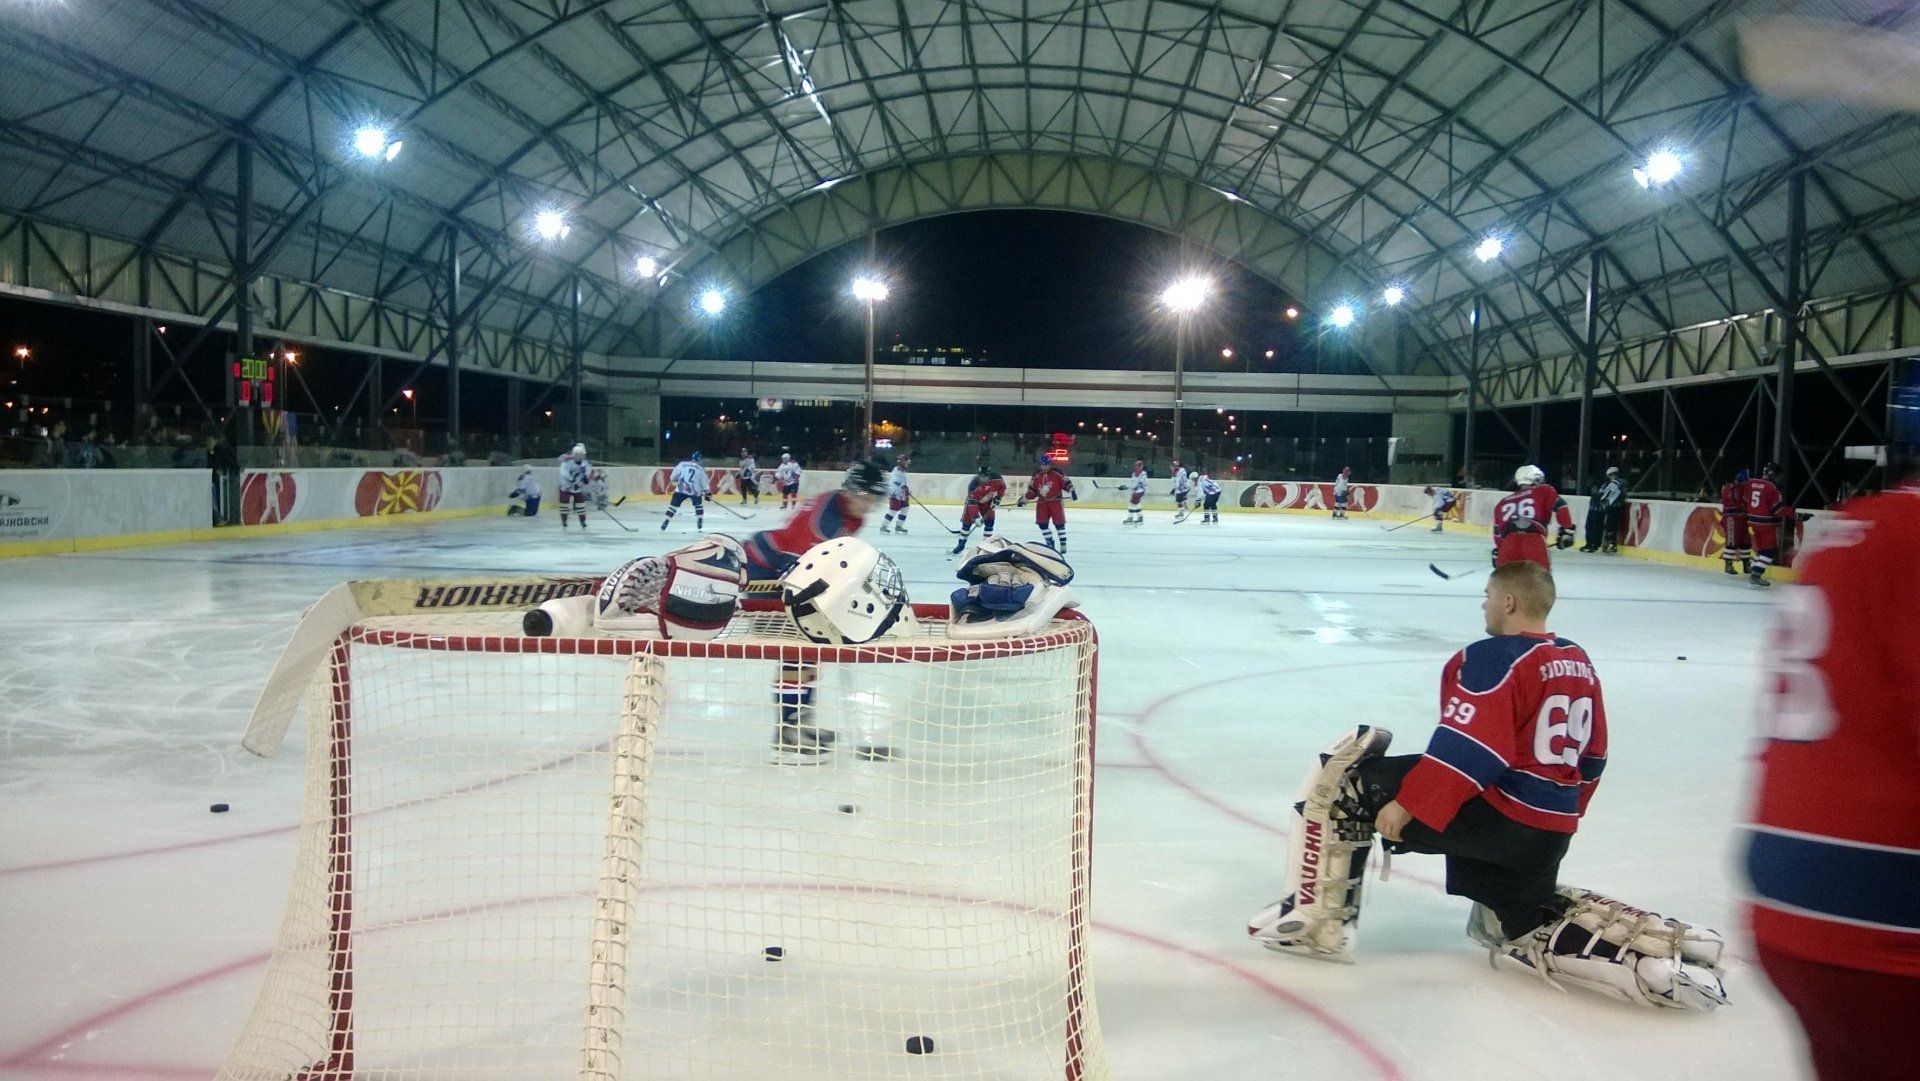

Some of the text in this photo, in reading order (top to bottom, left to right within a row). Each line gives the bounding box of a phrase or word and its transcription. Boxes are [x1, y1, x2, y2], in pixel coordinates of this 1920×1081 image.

[688, 469, 696, 483] 2
[1501, 498, 1535, 522] 26
[1751, 490, 1761, 508] 5
[1443, 696, 1477, 725] 69
[1533, 694, 1594, 768] 69
[1300, 818, 1322, 905] VAUGHN
